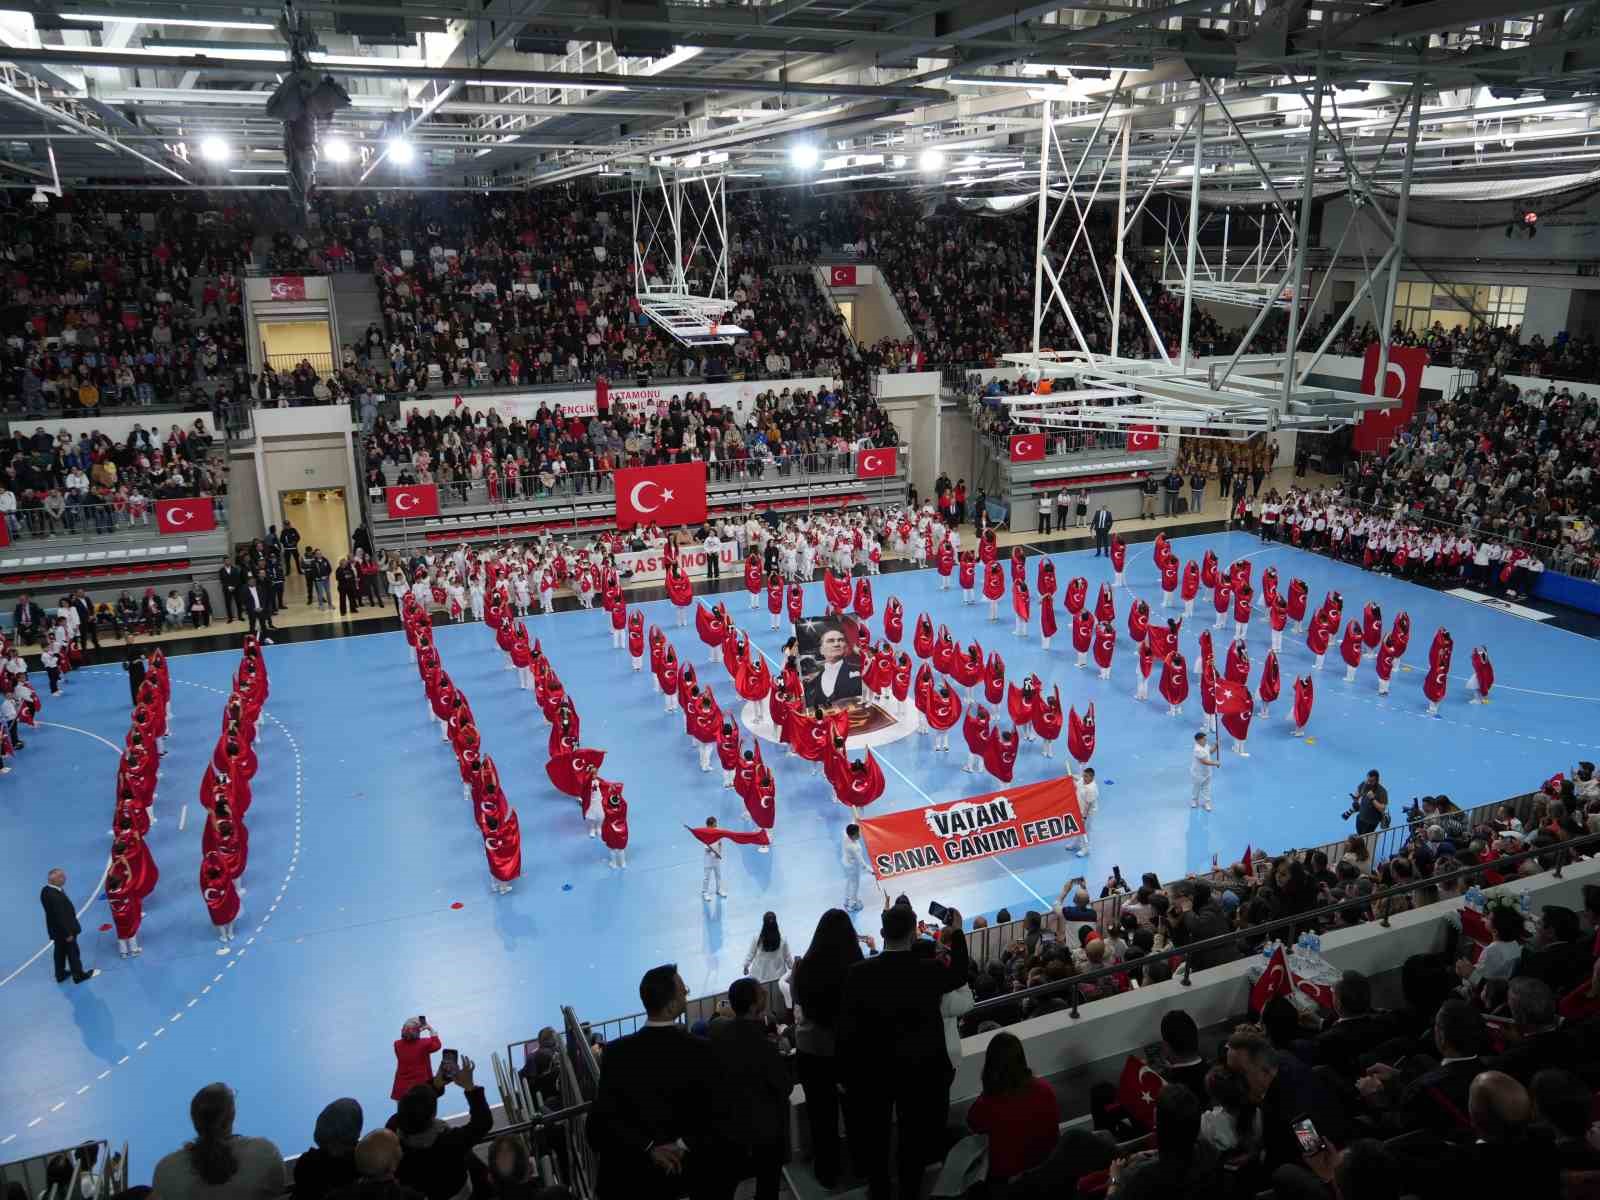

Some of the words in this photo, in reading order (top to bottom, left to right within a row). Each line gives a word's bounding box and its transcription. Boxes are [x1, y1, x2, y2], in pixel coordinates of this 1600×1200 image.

[932, 801, 1008, 835] VATAN
[877, 846, 941, 874] SANA
[944, 828, 1018, 861] CANIM
[1023, 815, 1078, 844] FEDA
